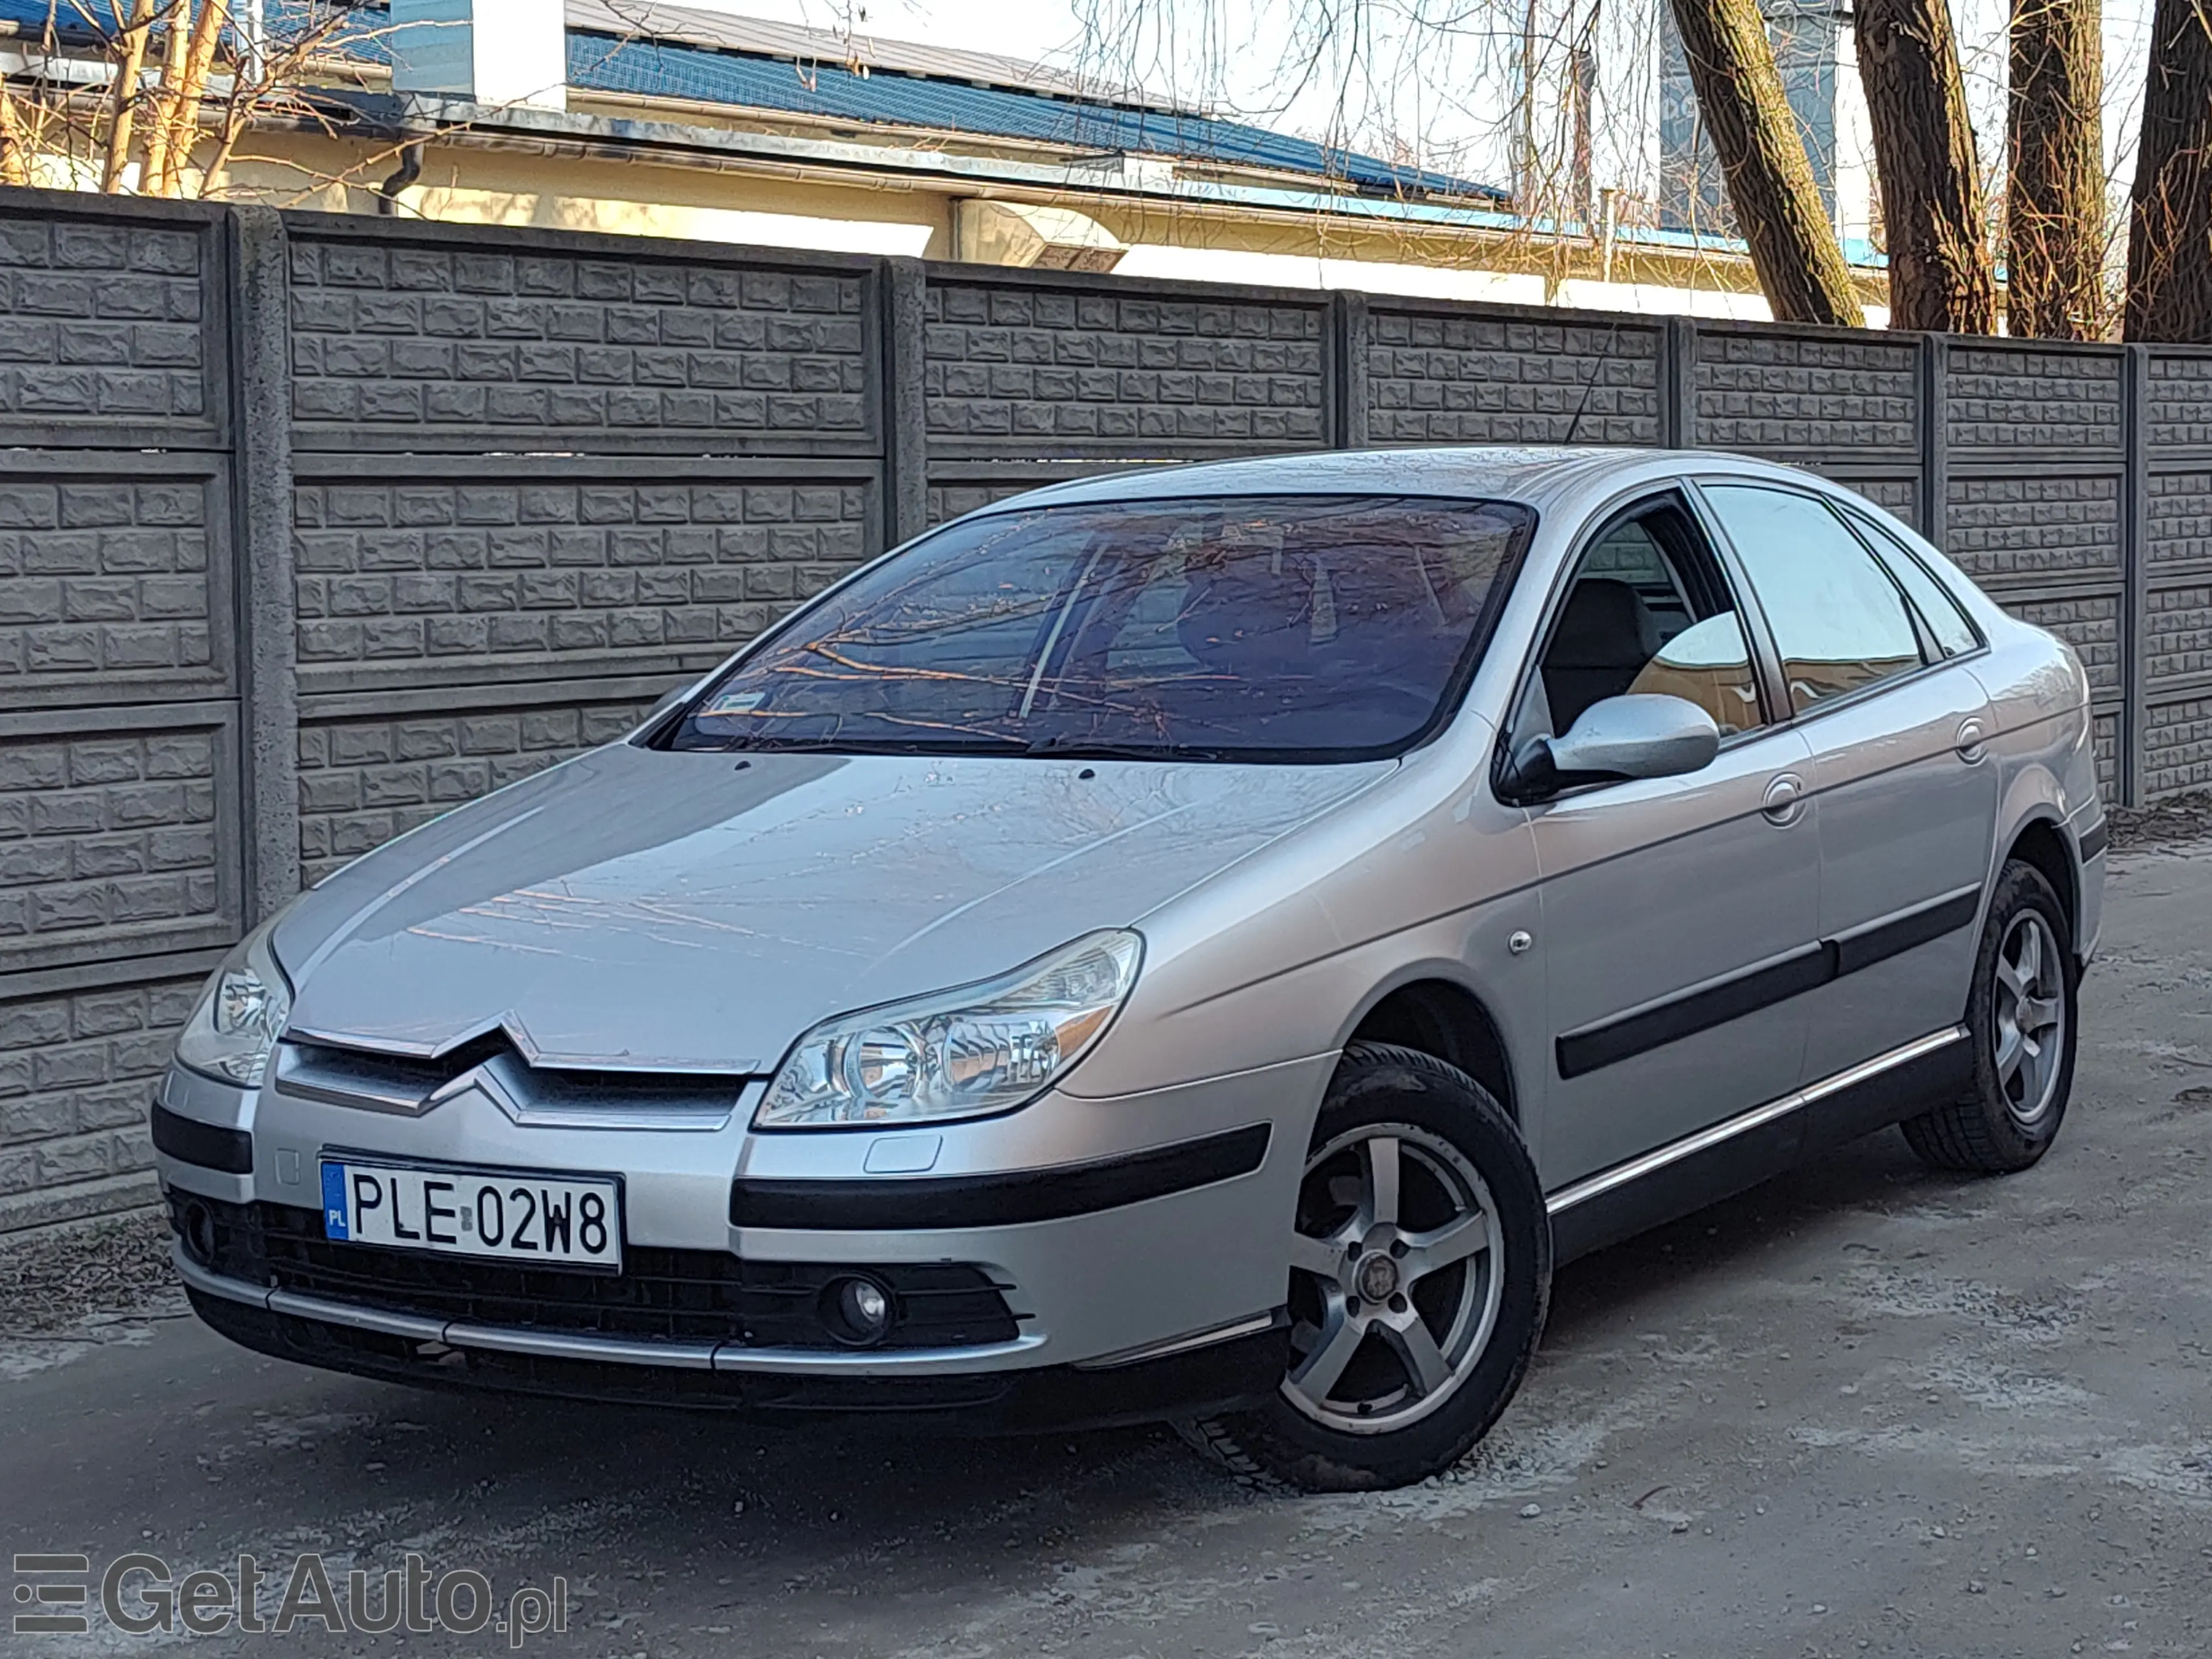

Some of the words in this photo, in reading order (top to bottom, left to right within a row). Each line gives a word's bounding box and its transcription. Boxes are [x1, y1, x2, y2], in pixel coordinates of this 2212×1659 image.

[328, 1210, 346, 1227] PL
[353, 1174, 457, 1244] PLE
[477, 1185, 607, 1254] 02W8
